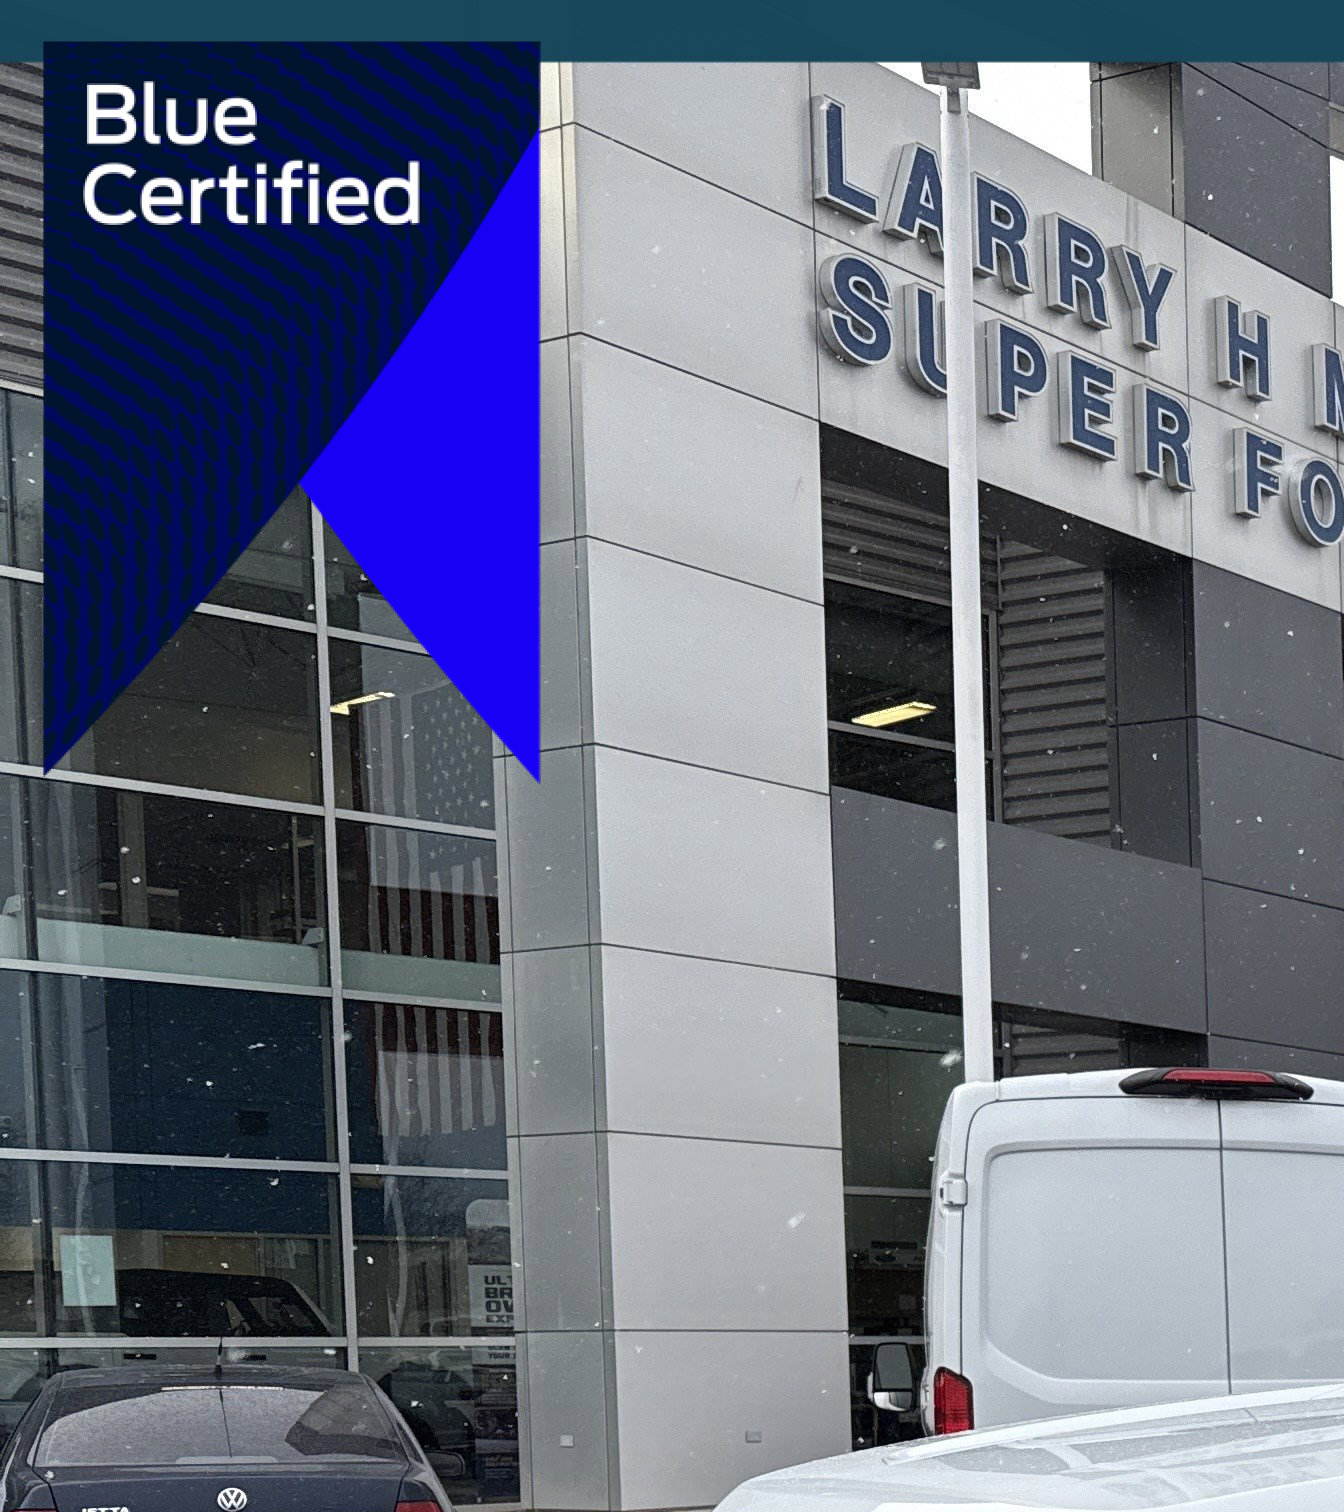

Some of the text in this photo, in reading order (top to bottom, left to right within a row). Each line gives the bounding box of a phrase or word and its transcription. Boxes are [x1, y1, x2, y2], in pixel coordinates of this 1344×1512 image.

[812, 94, 1177, 351] LARRY
[1214, 295, 1271, 402] H
[819, 253, 1195, 492] SUPER
